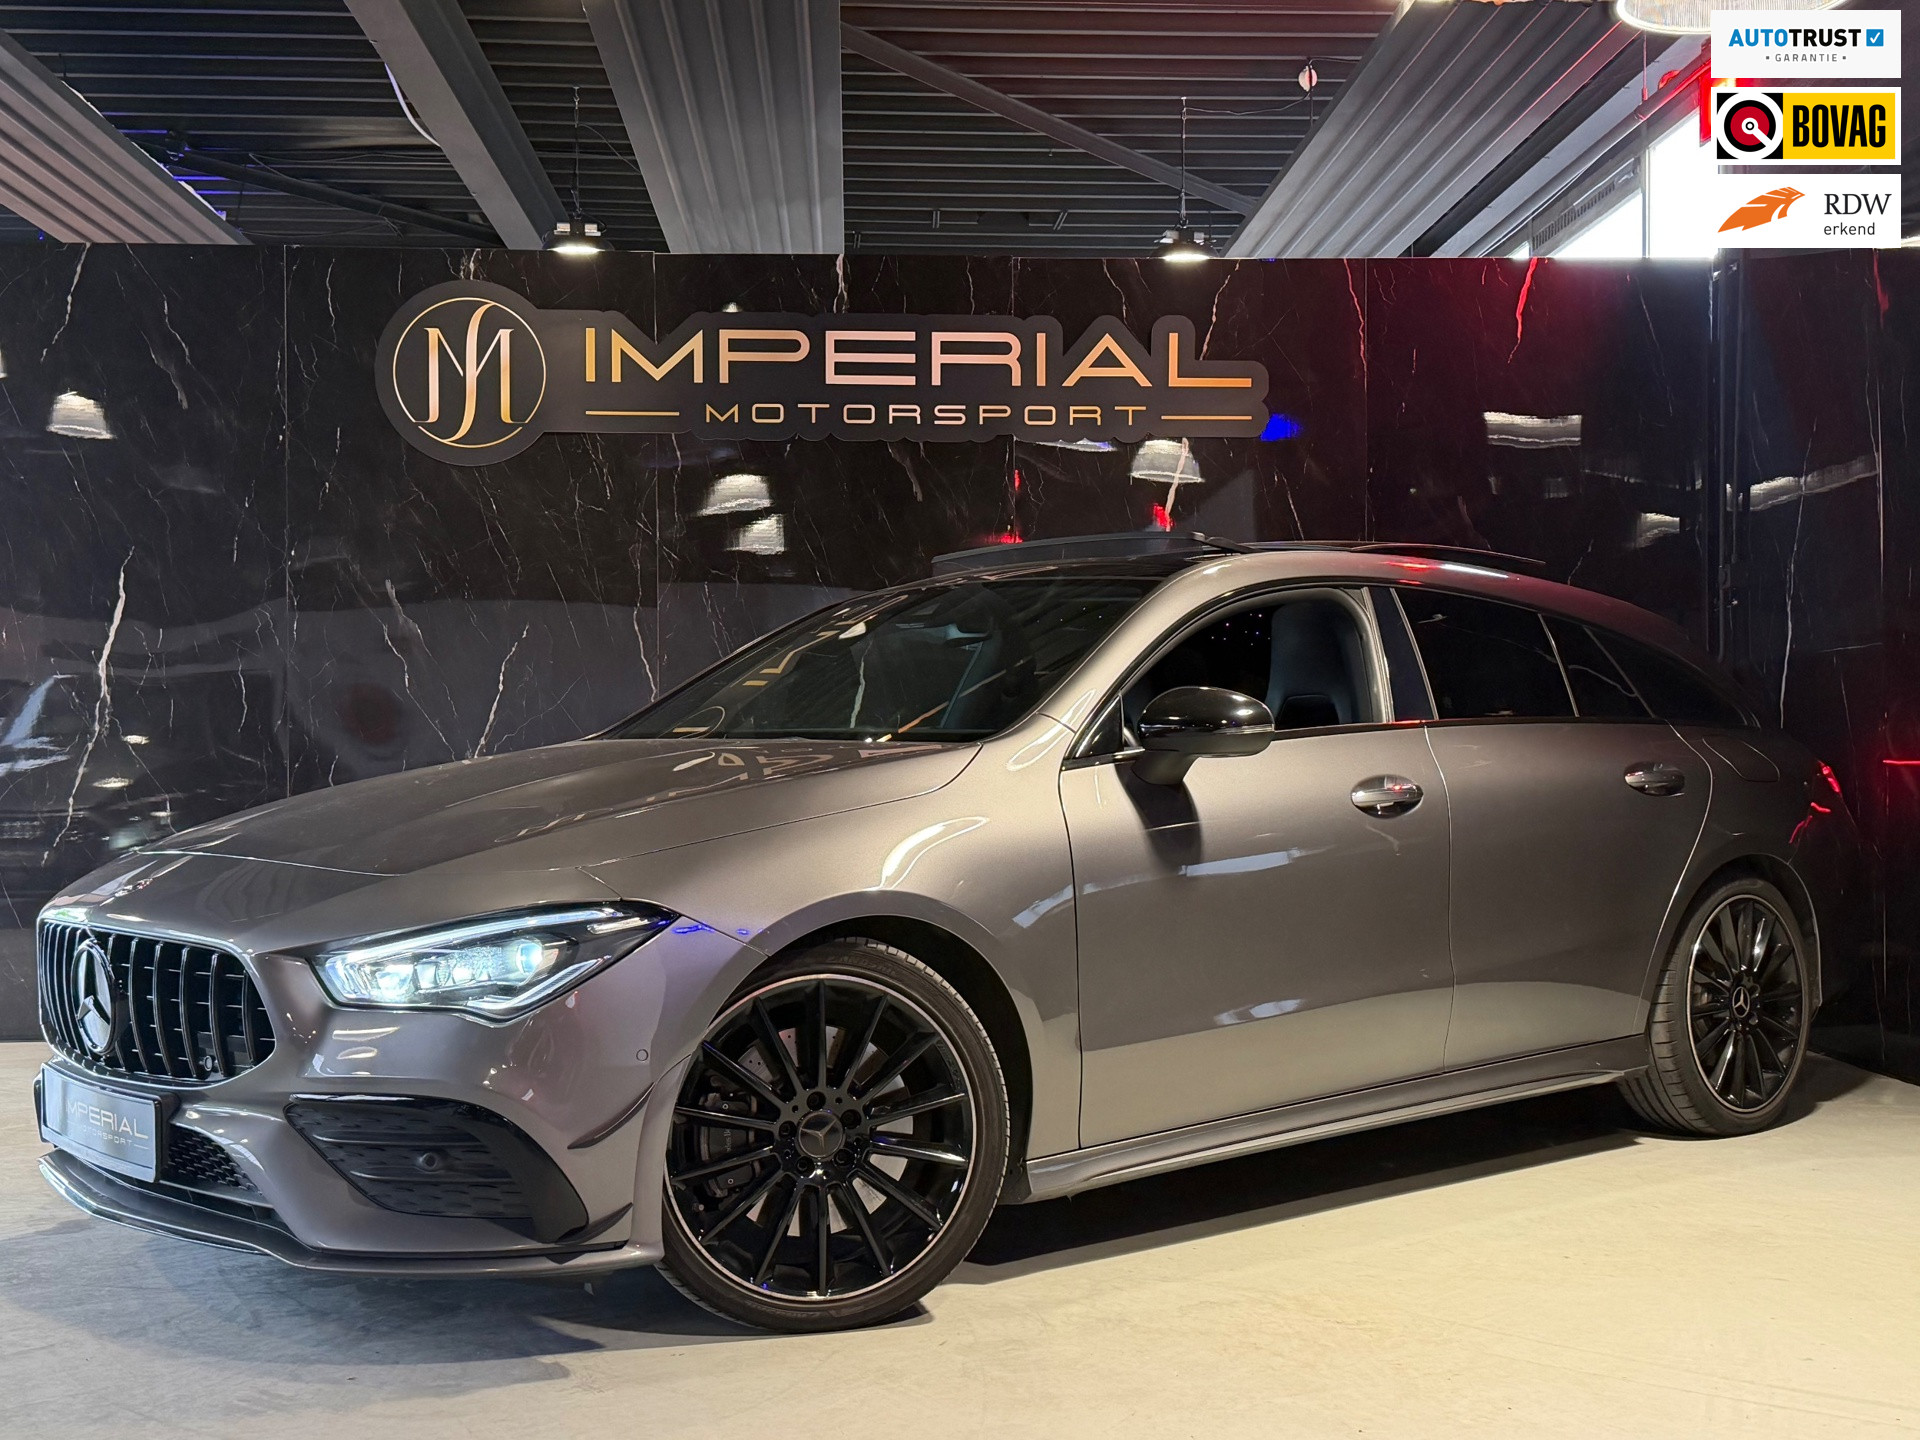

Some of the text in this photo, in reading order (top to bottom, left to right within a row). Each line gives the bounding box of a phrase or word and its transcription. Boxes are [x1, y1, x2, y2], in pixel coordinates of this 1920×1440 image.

[585, 327, 1252, 388] IMPERIAL
[705, 403, 1147, 426] MOTORSPORT
[66, 1100, 149, 1139] MPERIAL
[80, 1124, 132, 1146] OTORSPORT
